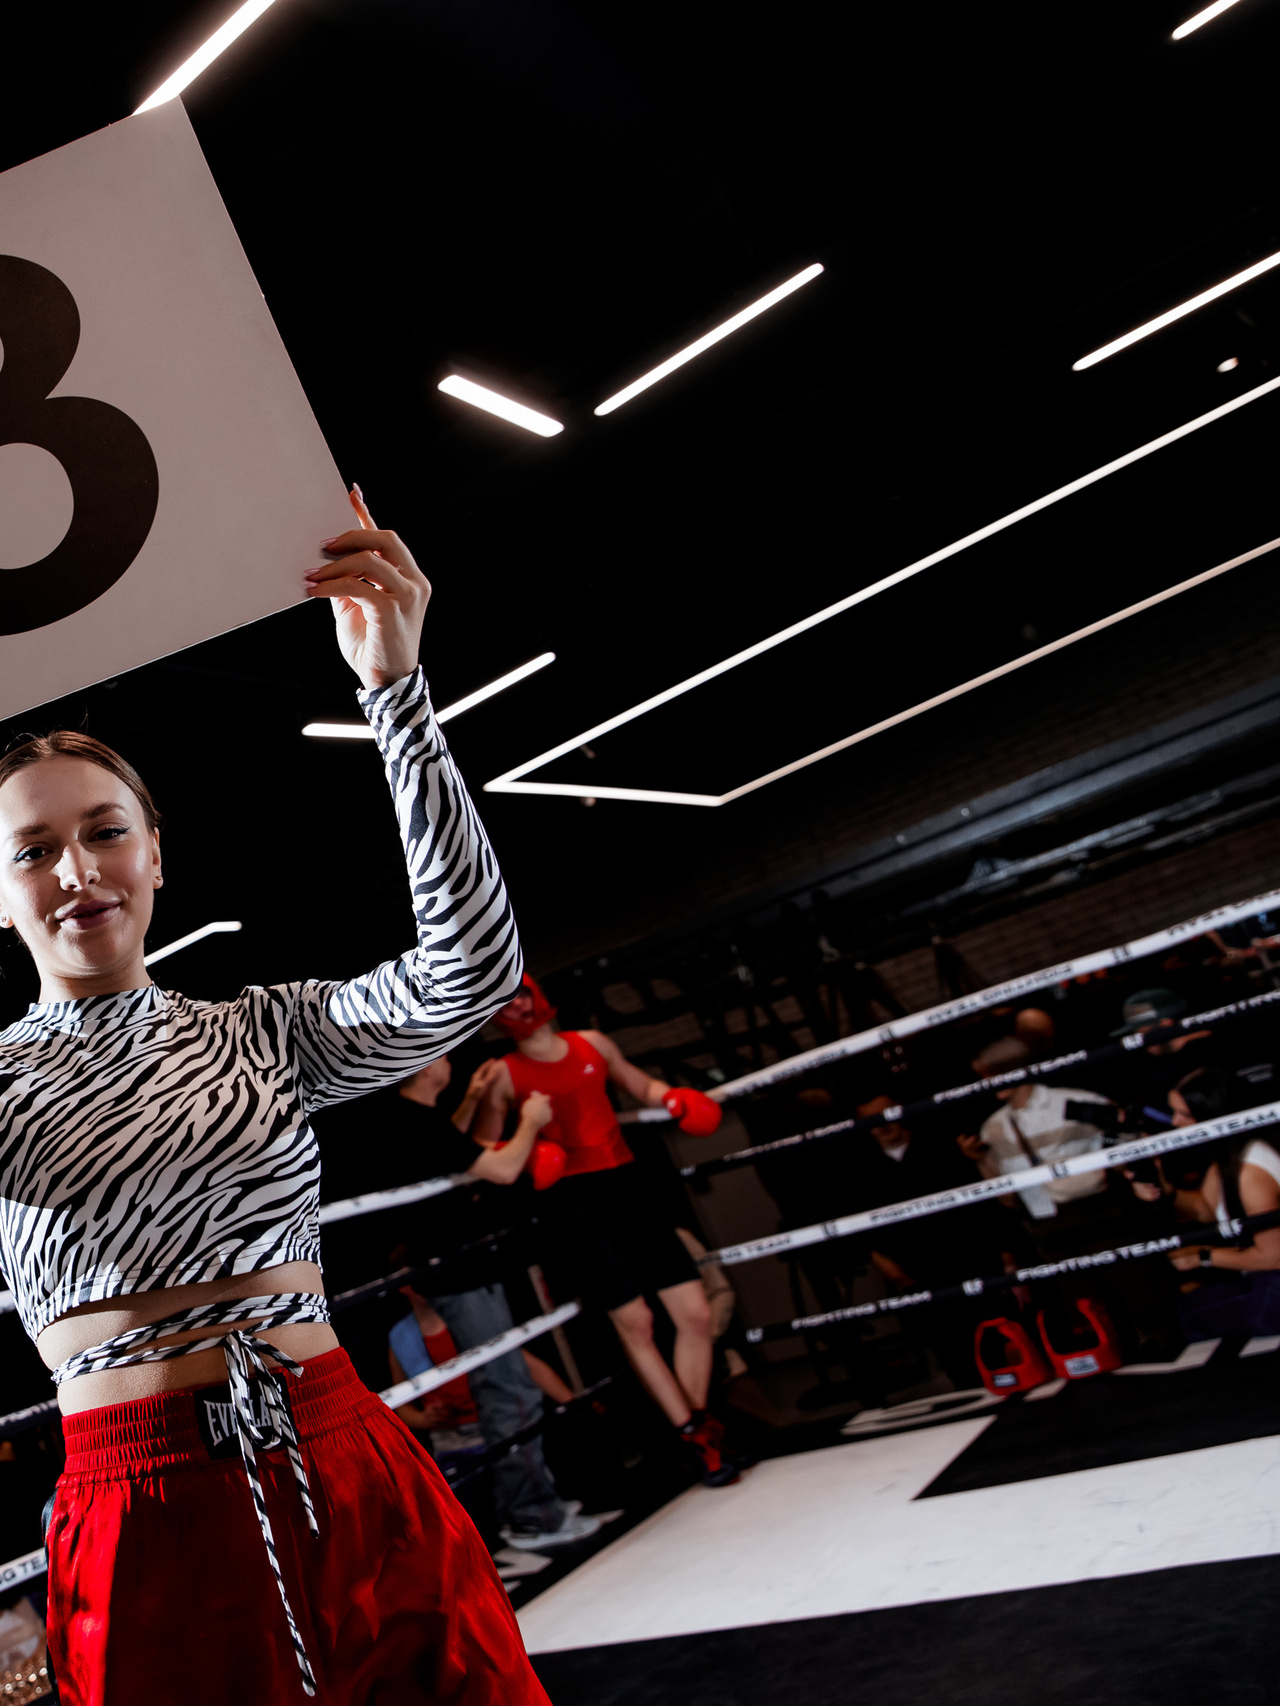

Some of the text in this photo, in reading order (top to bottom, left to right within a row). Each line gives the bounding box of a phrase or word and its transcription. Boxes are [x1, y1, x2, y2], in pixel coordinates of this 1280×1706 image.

[1215, 1108, 1279, 1135] TEAM
[1015, 1247, 1118, 1283] FIGHTING
[1116, 1234, 1182, 1260] TEAM
[16, 1553, 47, 1579] TE
